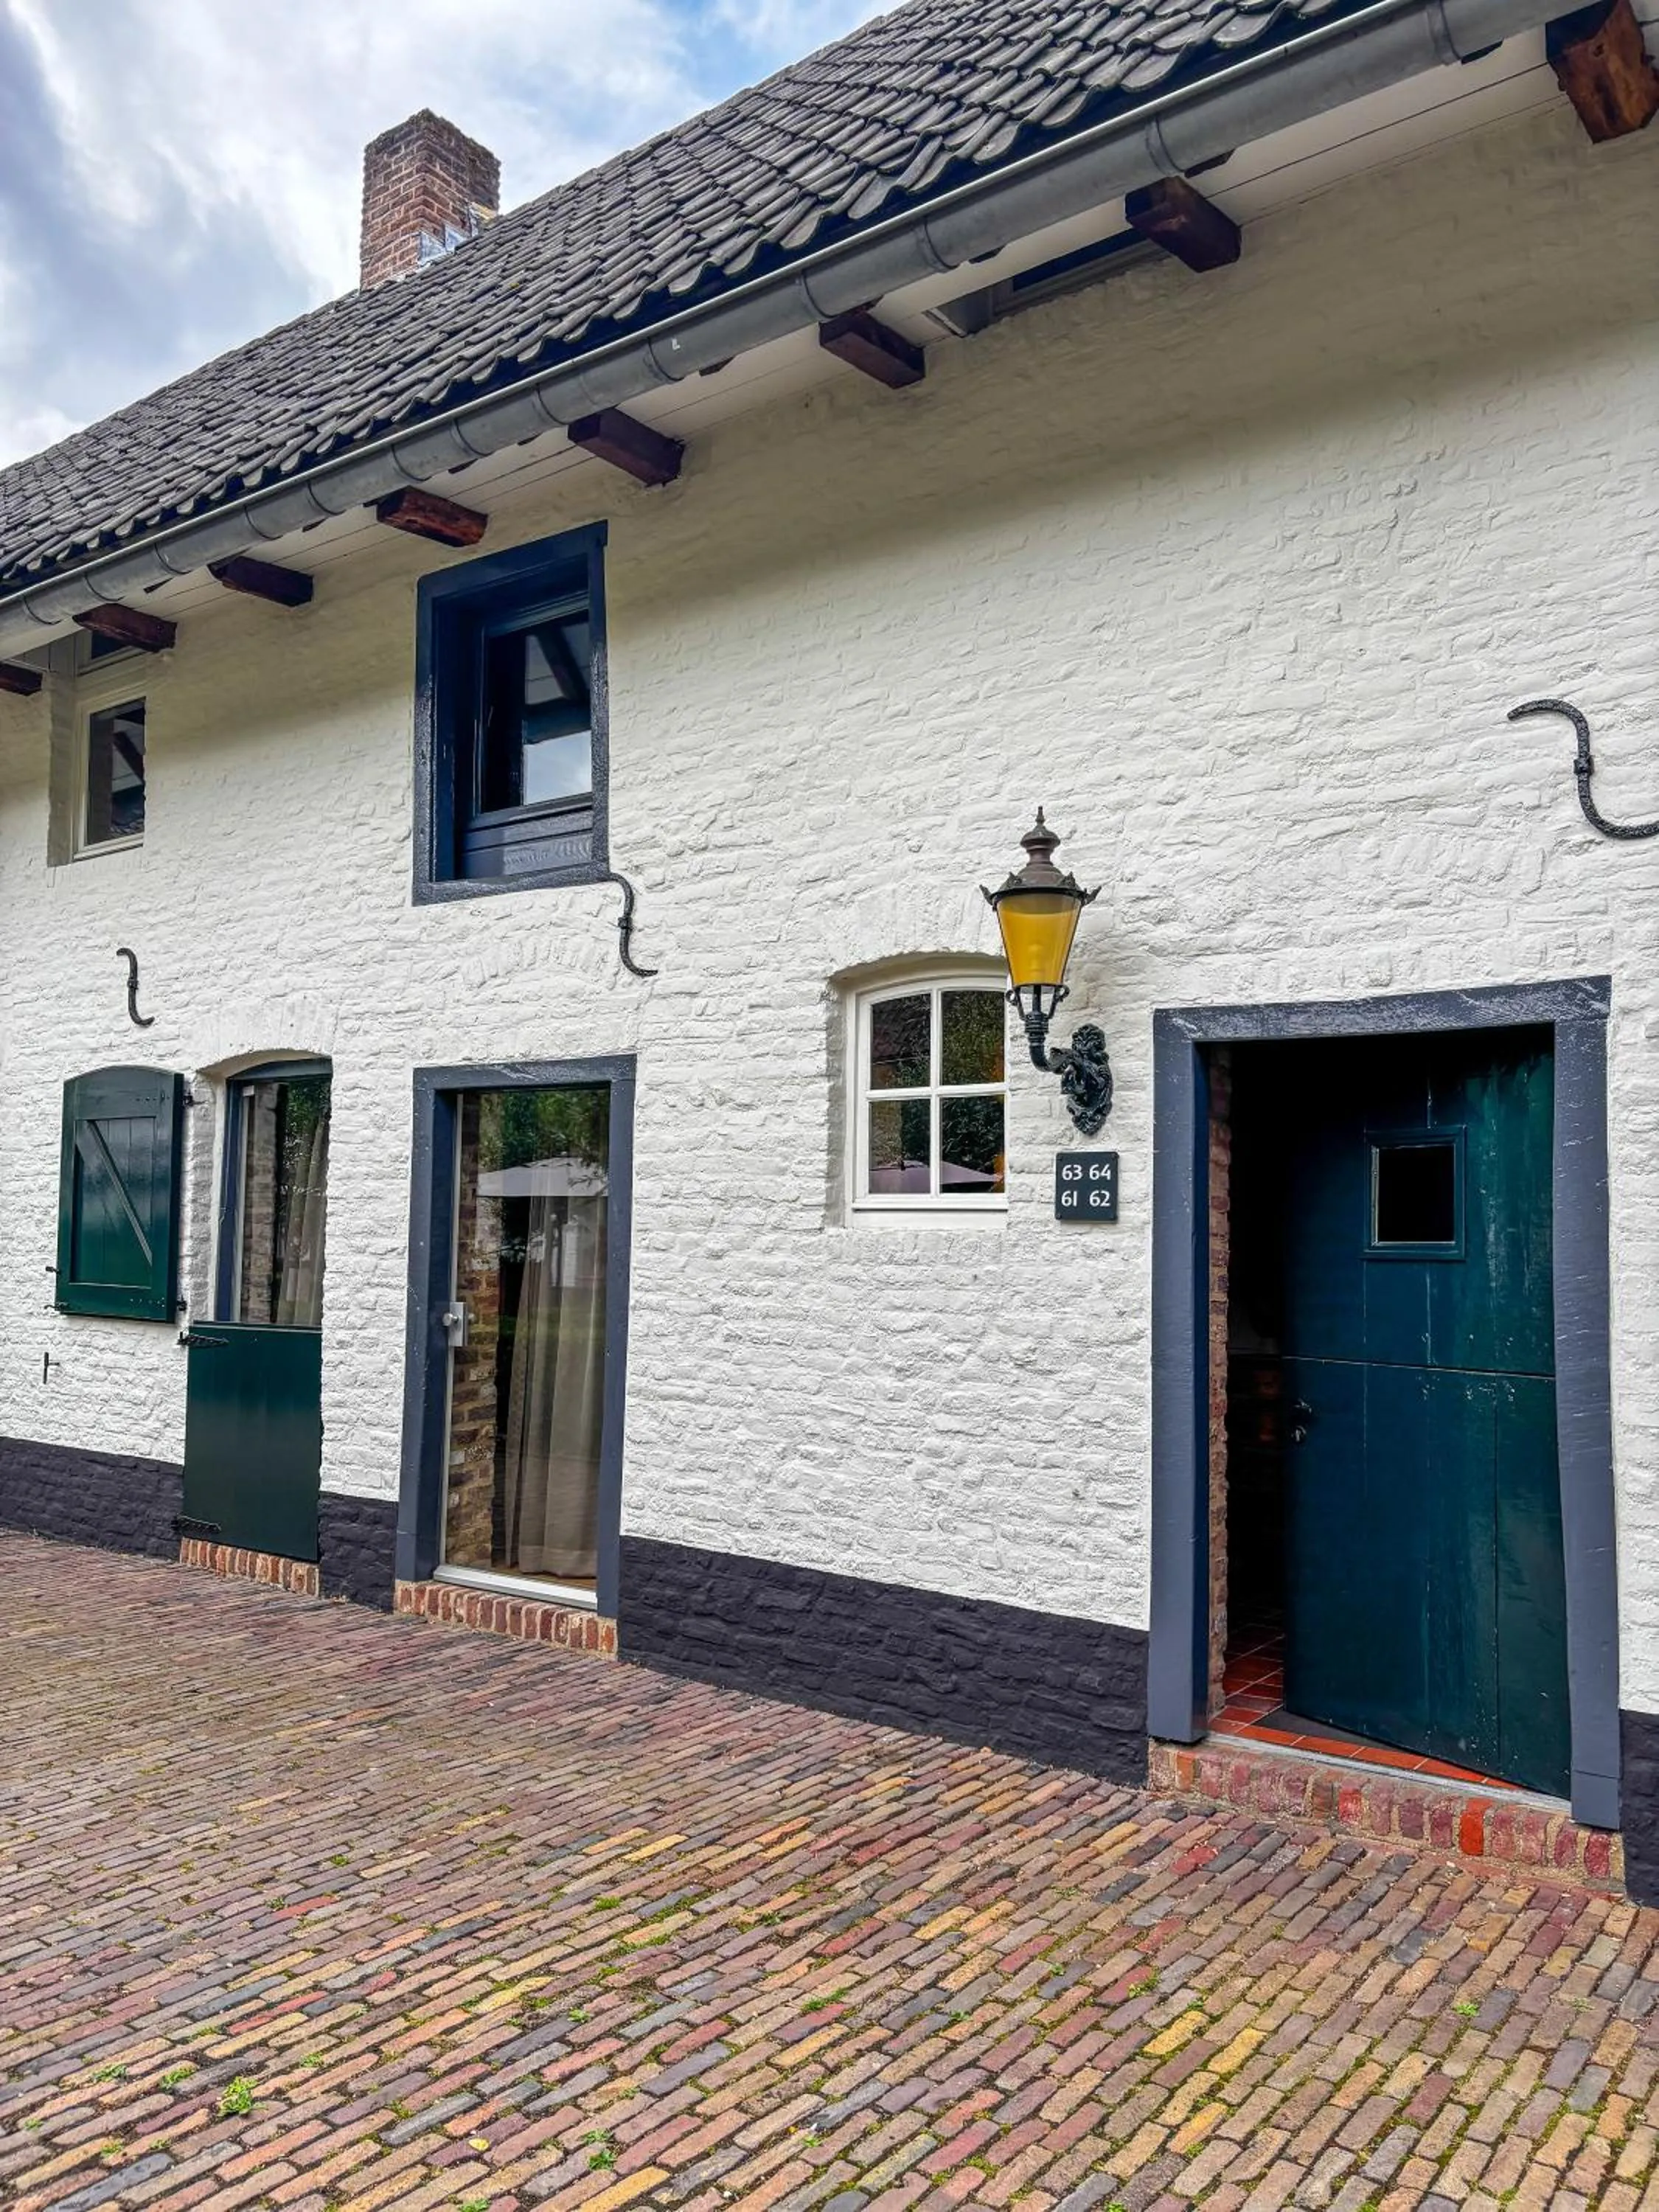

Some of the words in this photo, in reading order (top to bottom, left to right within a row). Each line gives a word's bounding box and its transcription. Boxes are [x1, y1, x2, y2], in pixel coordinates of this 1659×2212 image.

[1062, 1164, 1083, 1180] 63
[1089, 1164, 1111, 1180] 64
[1061, 1190, 1078, 1207] 61
[1089, 1190, 1110, 1207] 62
